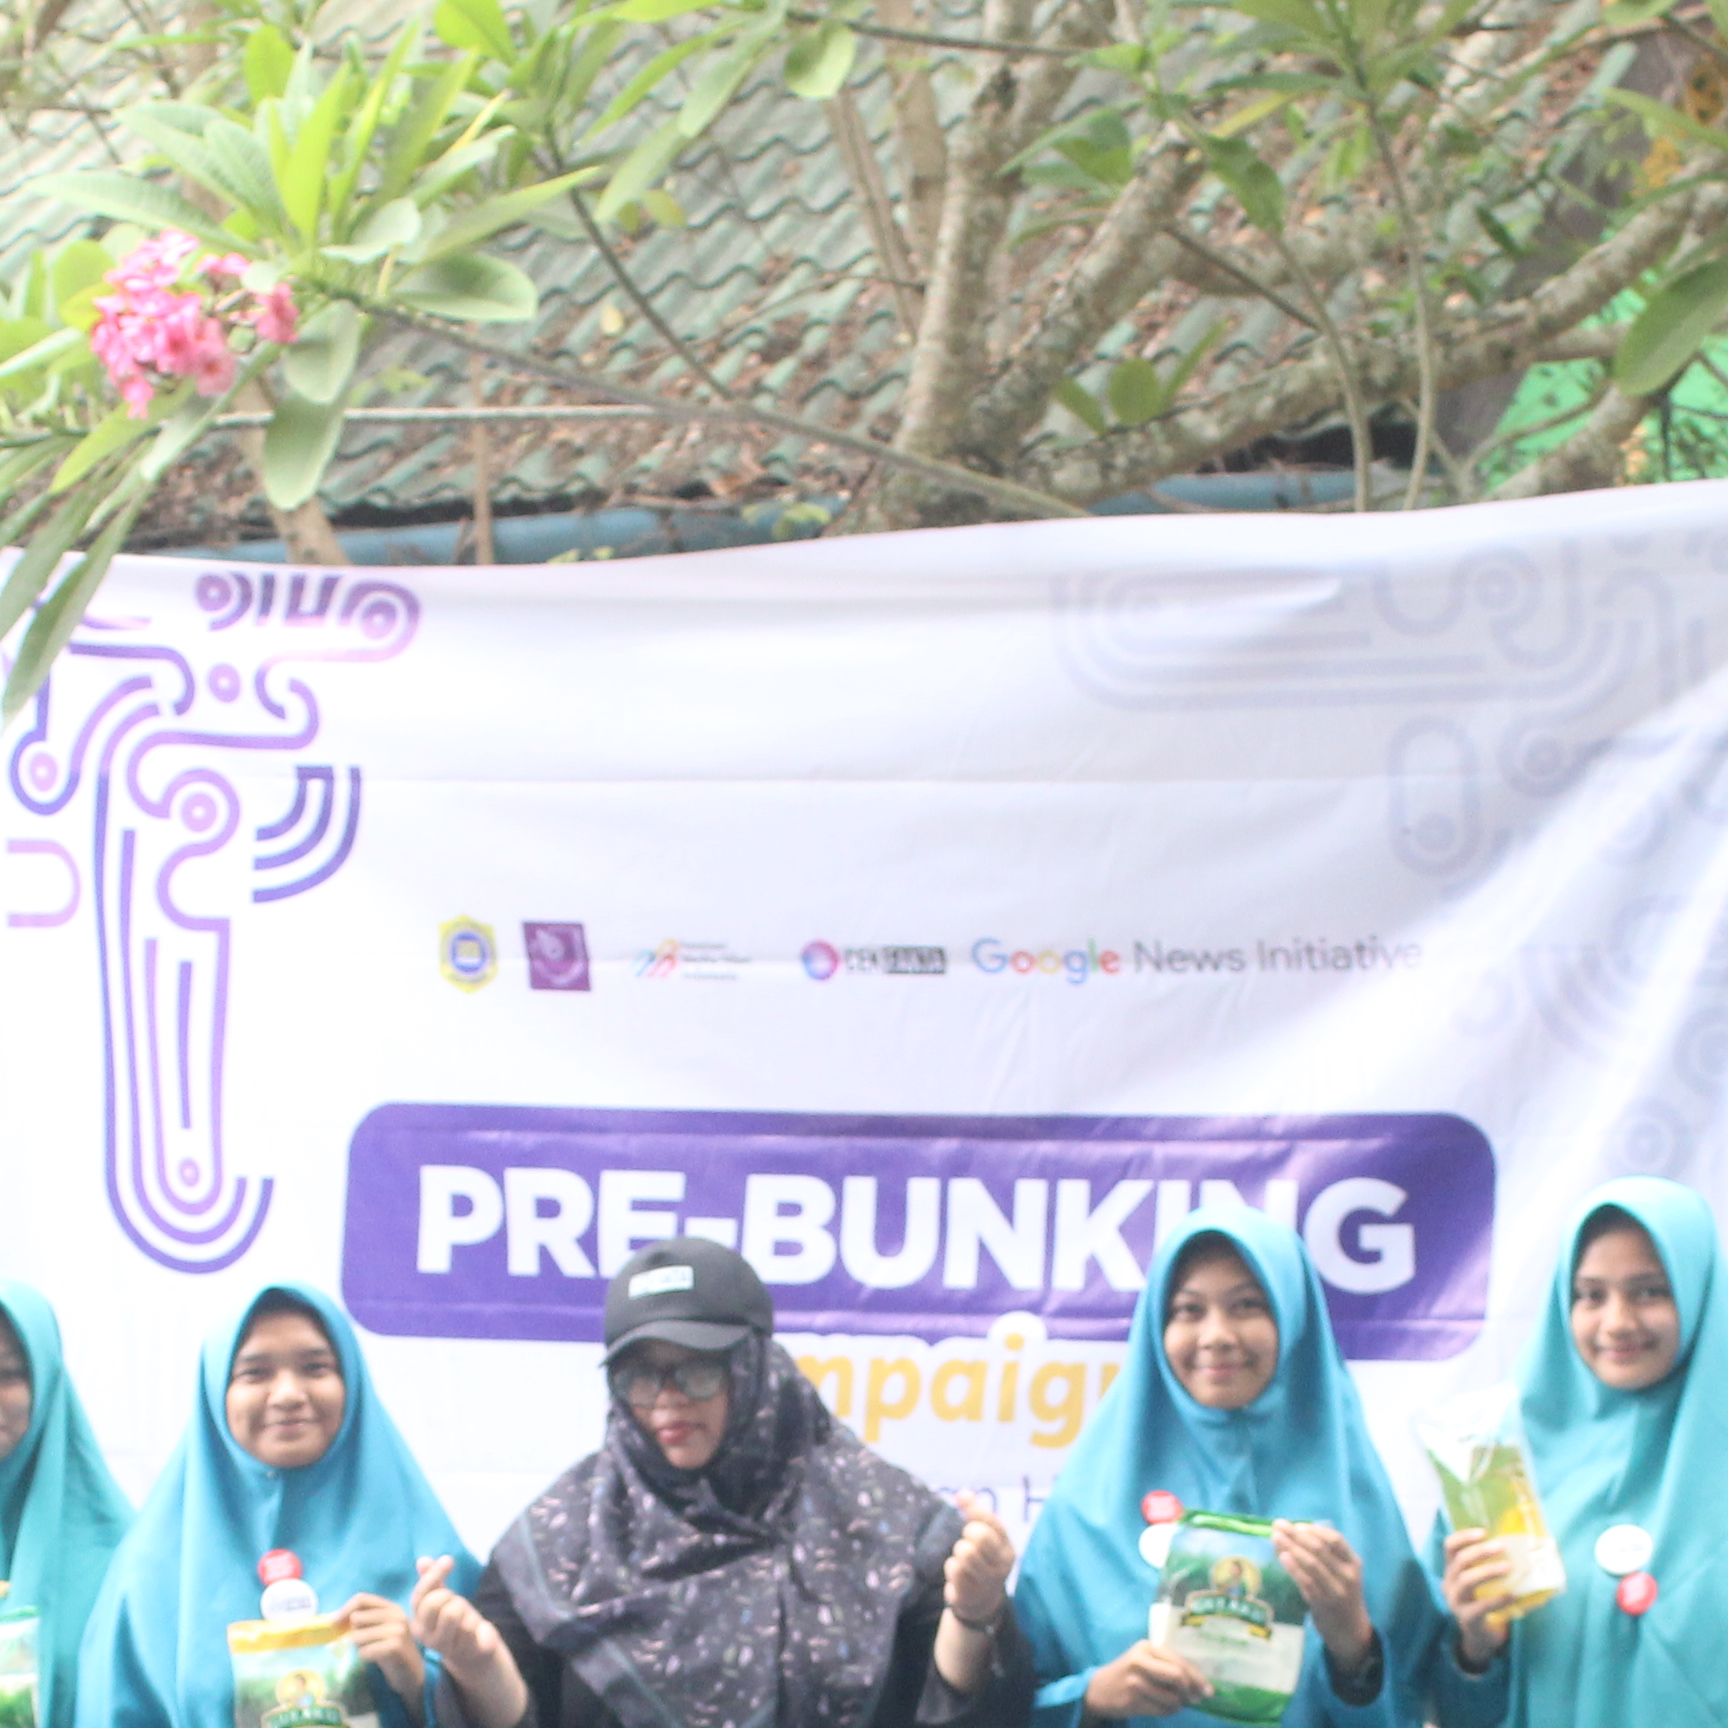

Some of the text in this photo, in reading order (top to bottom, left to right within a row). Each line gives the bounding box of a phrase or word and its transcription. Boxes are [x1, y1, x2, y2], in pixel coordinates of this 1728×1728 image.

[971, 935, 1121, 985] Google
[1133, 939, 1246, 973] News
[1257, 936, 1424, 973] Initiative
